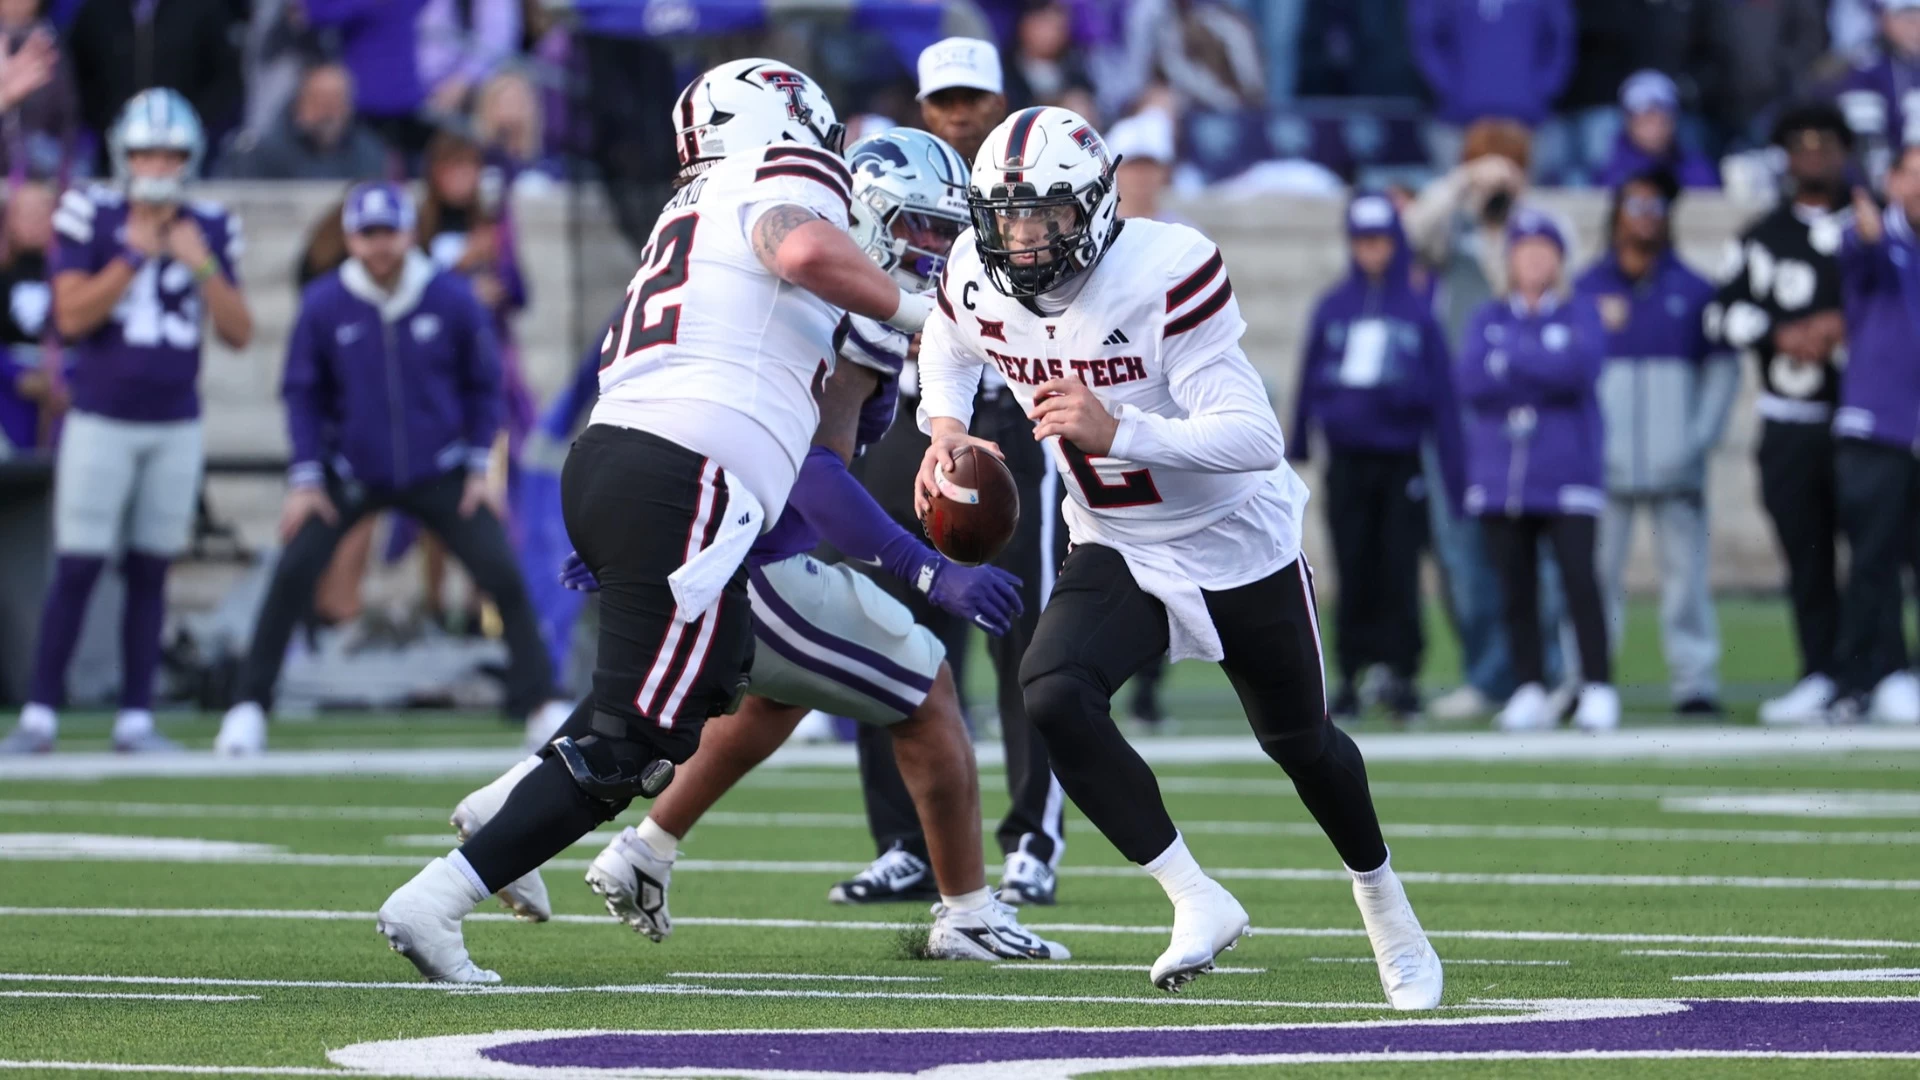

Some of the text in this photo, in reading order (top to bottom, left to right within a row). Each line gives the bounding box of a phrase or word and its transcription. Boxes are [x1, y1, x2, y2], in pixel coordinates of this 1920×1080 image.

[963, 280, 979, 311] C
[985, 349, 1148, 388] TEXAS TECH
